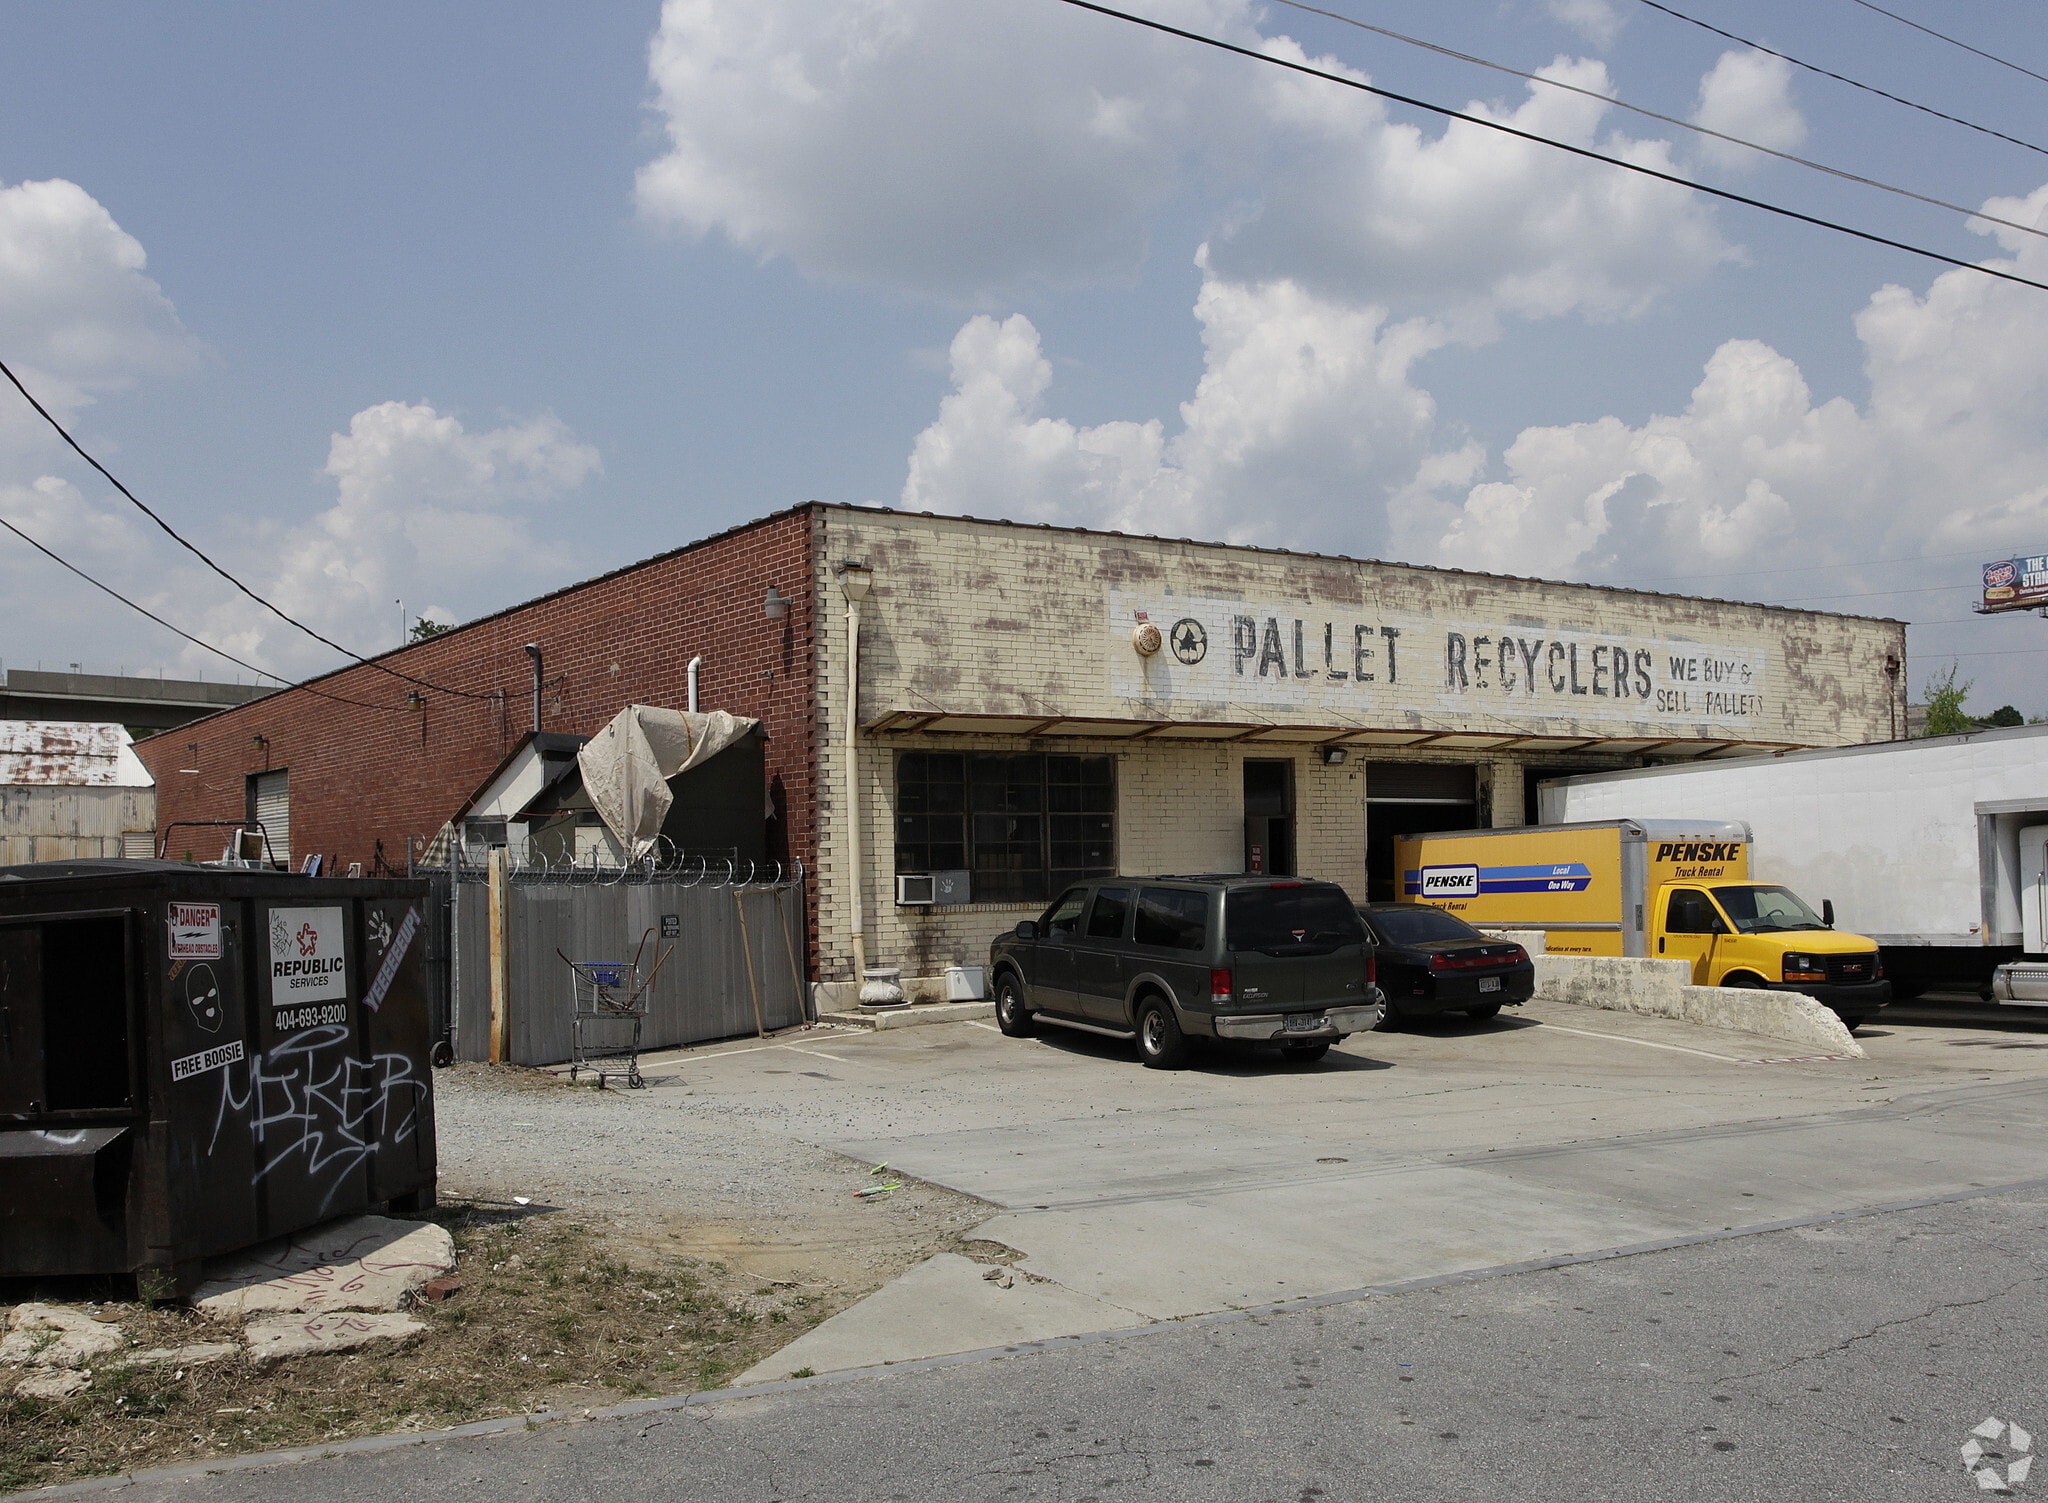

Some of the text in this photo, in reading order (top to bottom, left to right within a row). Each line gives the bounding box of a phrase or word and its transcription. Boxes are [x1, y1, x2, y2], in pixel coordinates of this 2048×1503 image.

[2026, 557, 2044, 572] THE
[1234, 614, 1651, 699] PALLET RECYCLERS
[1669, 656, 1752, 684] WE BUY &
[1657, 689, 1762, 716] SELL PALLETS
[1655, 843, 1740, 862] PENSKE
[1552, 866, 1571, 875] Local
[1675, 866, 1724, 877] Truck Rental
[1425, 875, 1474, 888] PENSKE
[1548, 879, 1575, 891] One Way
[1447, 901, 1467, 911] Rental
[180, 908, 210, 927] DANGER
[273, 957, 343, 977] REPUBLIC
[289, 976, 328, 988] SERVICES
[275, 1004, 347, 1031] 404-693-9200
[174, 1043, 241, 1077] FREE BOOSIE
